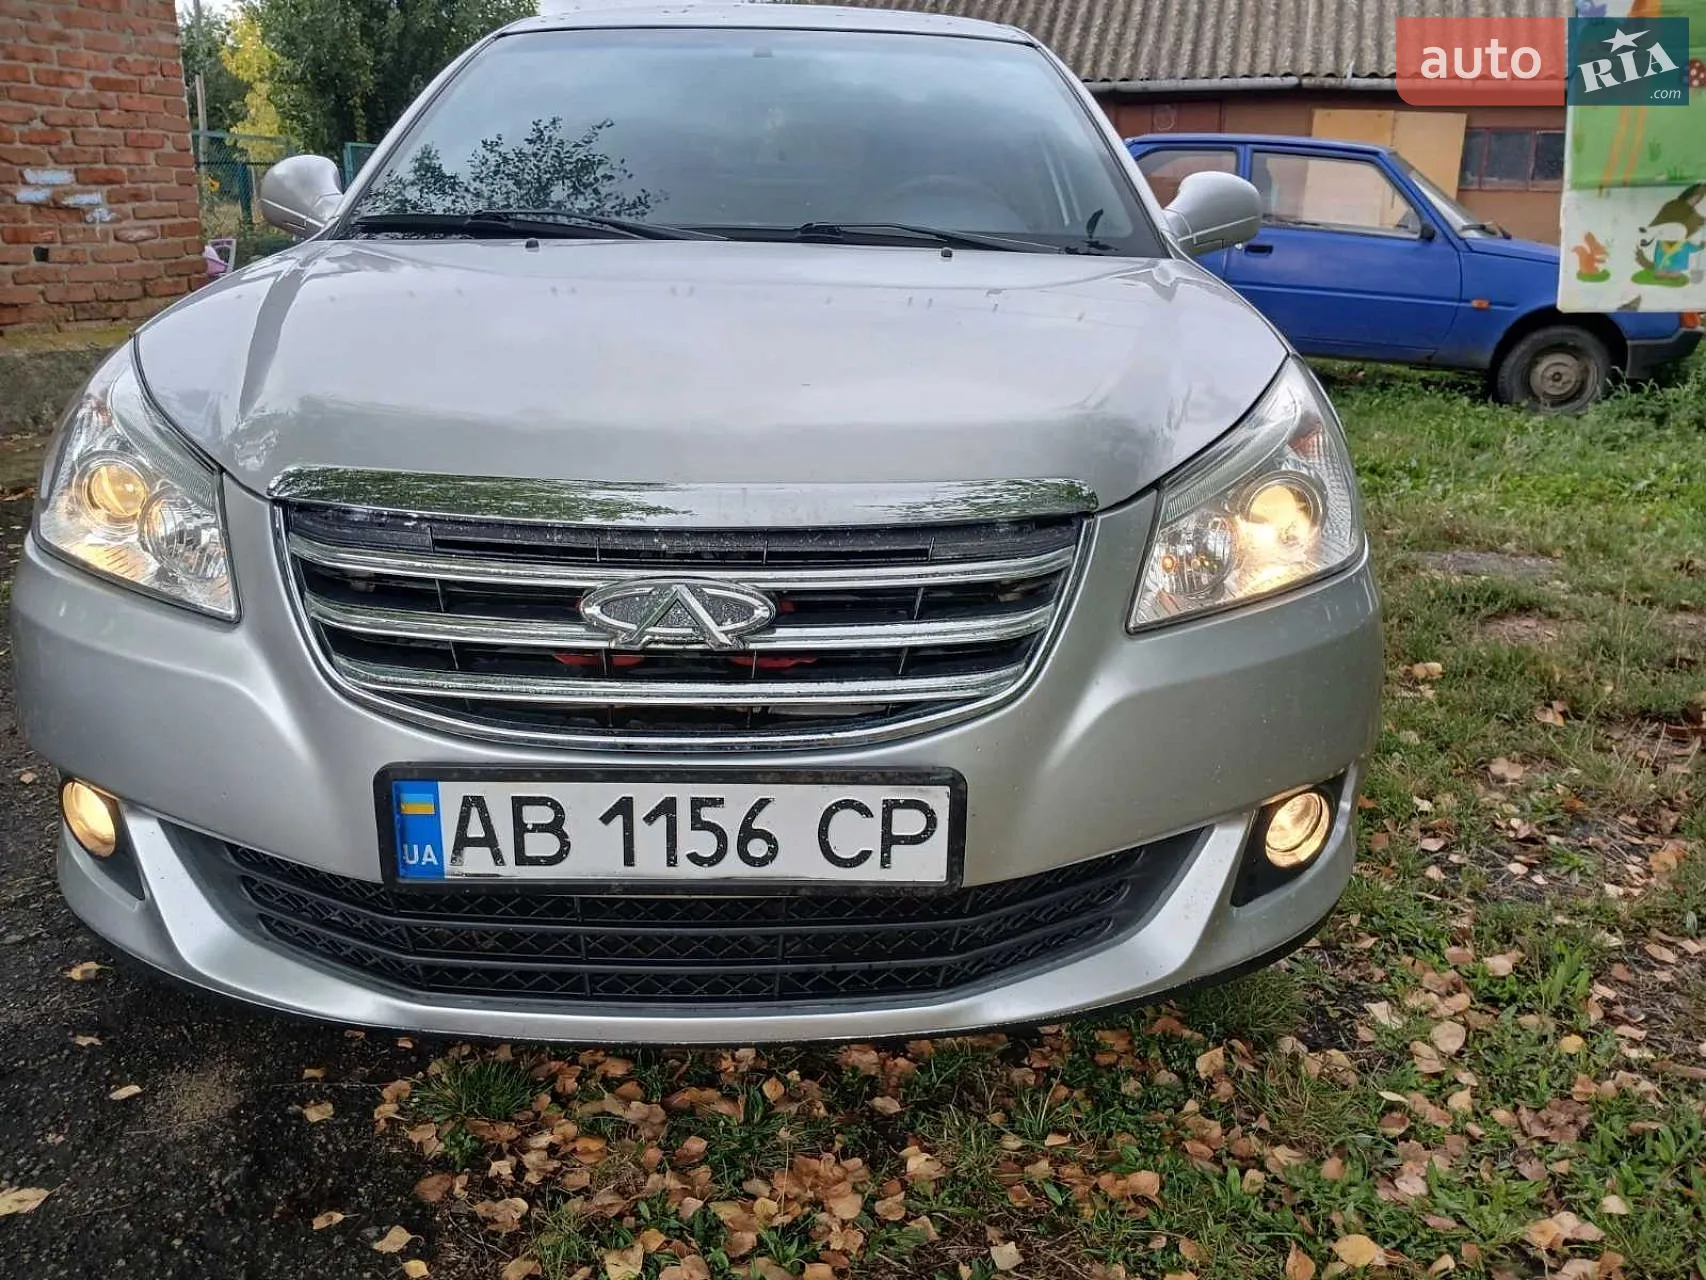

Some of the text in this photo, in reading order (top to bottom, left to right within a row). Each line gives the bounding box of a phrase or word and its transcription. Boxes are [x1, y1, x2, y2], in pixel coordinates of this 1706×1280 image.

[403, 842, 438, 867] UA
[449, 795, 938, 870] AB 1156 CP
